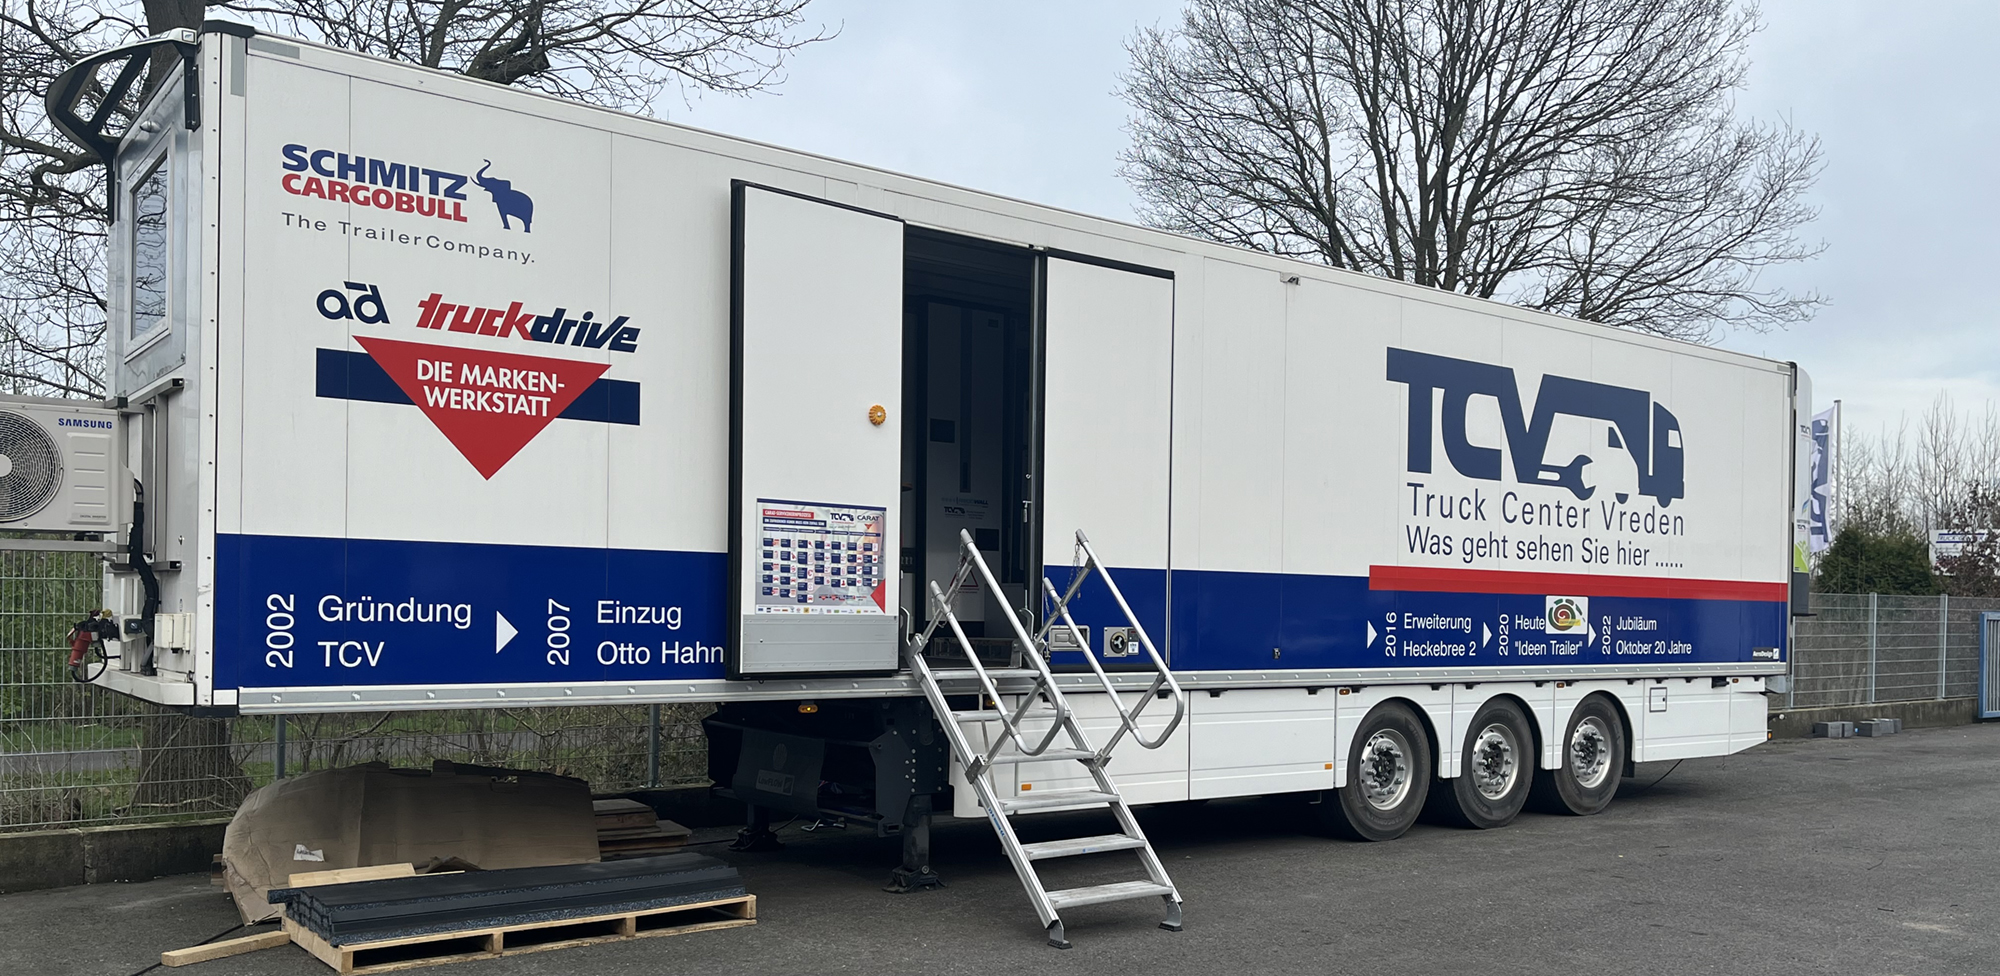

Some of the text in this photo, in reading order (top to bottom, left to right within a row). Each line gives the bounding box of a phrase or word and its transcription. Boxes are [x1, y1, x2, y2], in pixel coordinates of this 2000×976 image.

[281, 143, 468, 201] SCHMITZ
[281, 173, 468, 223] CARGOBULL
[281, 212, 327, 231] The
[416, 293, 641, 353] truckdrive
[417, 359, 565, 394] DIE MARKEN-
[423, 385, 551, 417] WERKSTATT
[58, 417, 113, 430] SAMSUNG
[1406, 482, 1684, 536] Truck Center Vreden
[1406, 524, 1453, 556] Was
[1462, 531, 1508, 564] geht
[1516, 534, 1573, 563] sehen
[1581, 537, 1610, 565] Sie
[1617, 540, 1650, 567] hier
[317, 594, 472, 630] Gründung
[597, 600, 682, 630] Einzug
[1404, 612, 1472, 633] Erweiterung
[1515, 615, 1545, 630] Heute
[1616, 615, 1657, 631] Jubiläum
[265, 593, 295, 668] 2002
[546, 598, 571, 666] 2007
[1385, 611, 1397, 657] 2016
[1498, 613, 1509, 656] 2020
[1601, 615, 1611, 655] 2022
[1616, 640, 1692, 655] Oktober 20 Jahre
[317, 641, 385, 668] TCV
[597, 640, 724, 665] Otto Hahn
[1403, 640, 1476, 657] Heckebree 2
